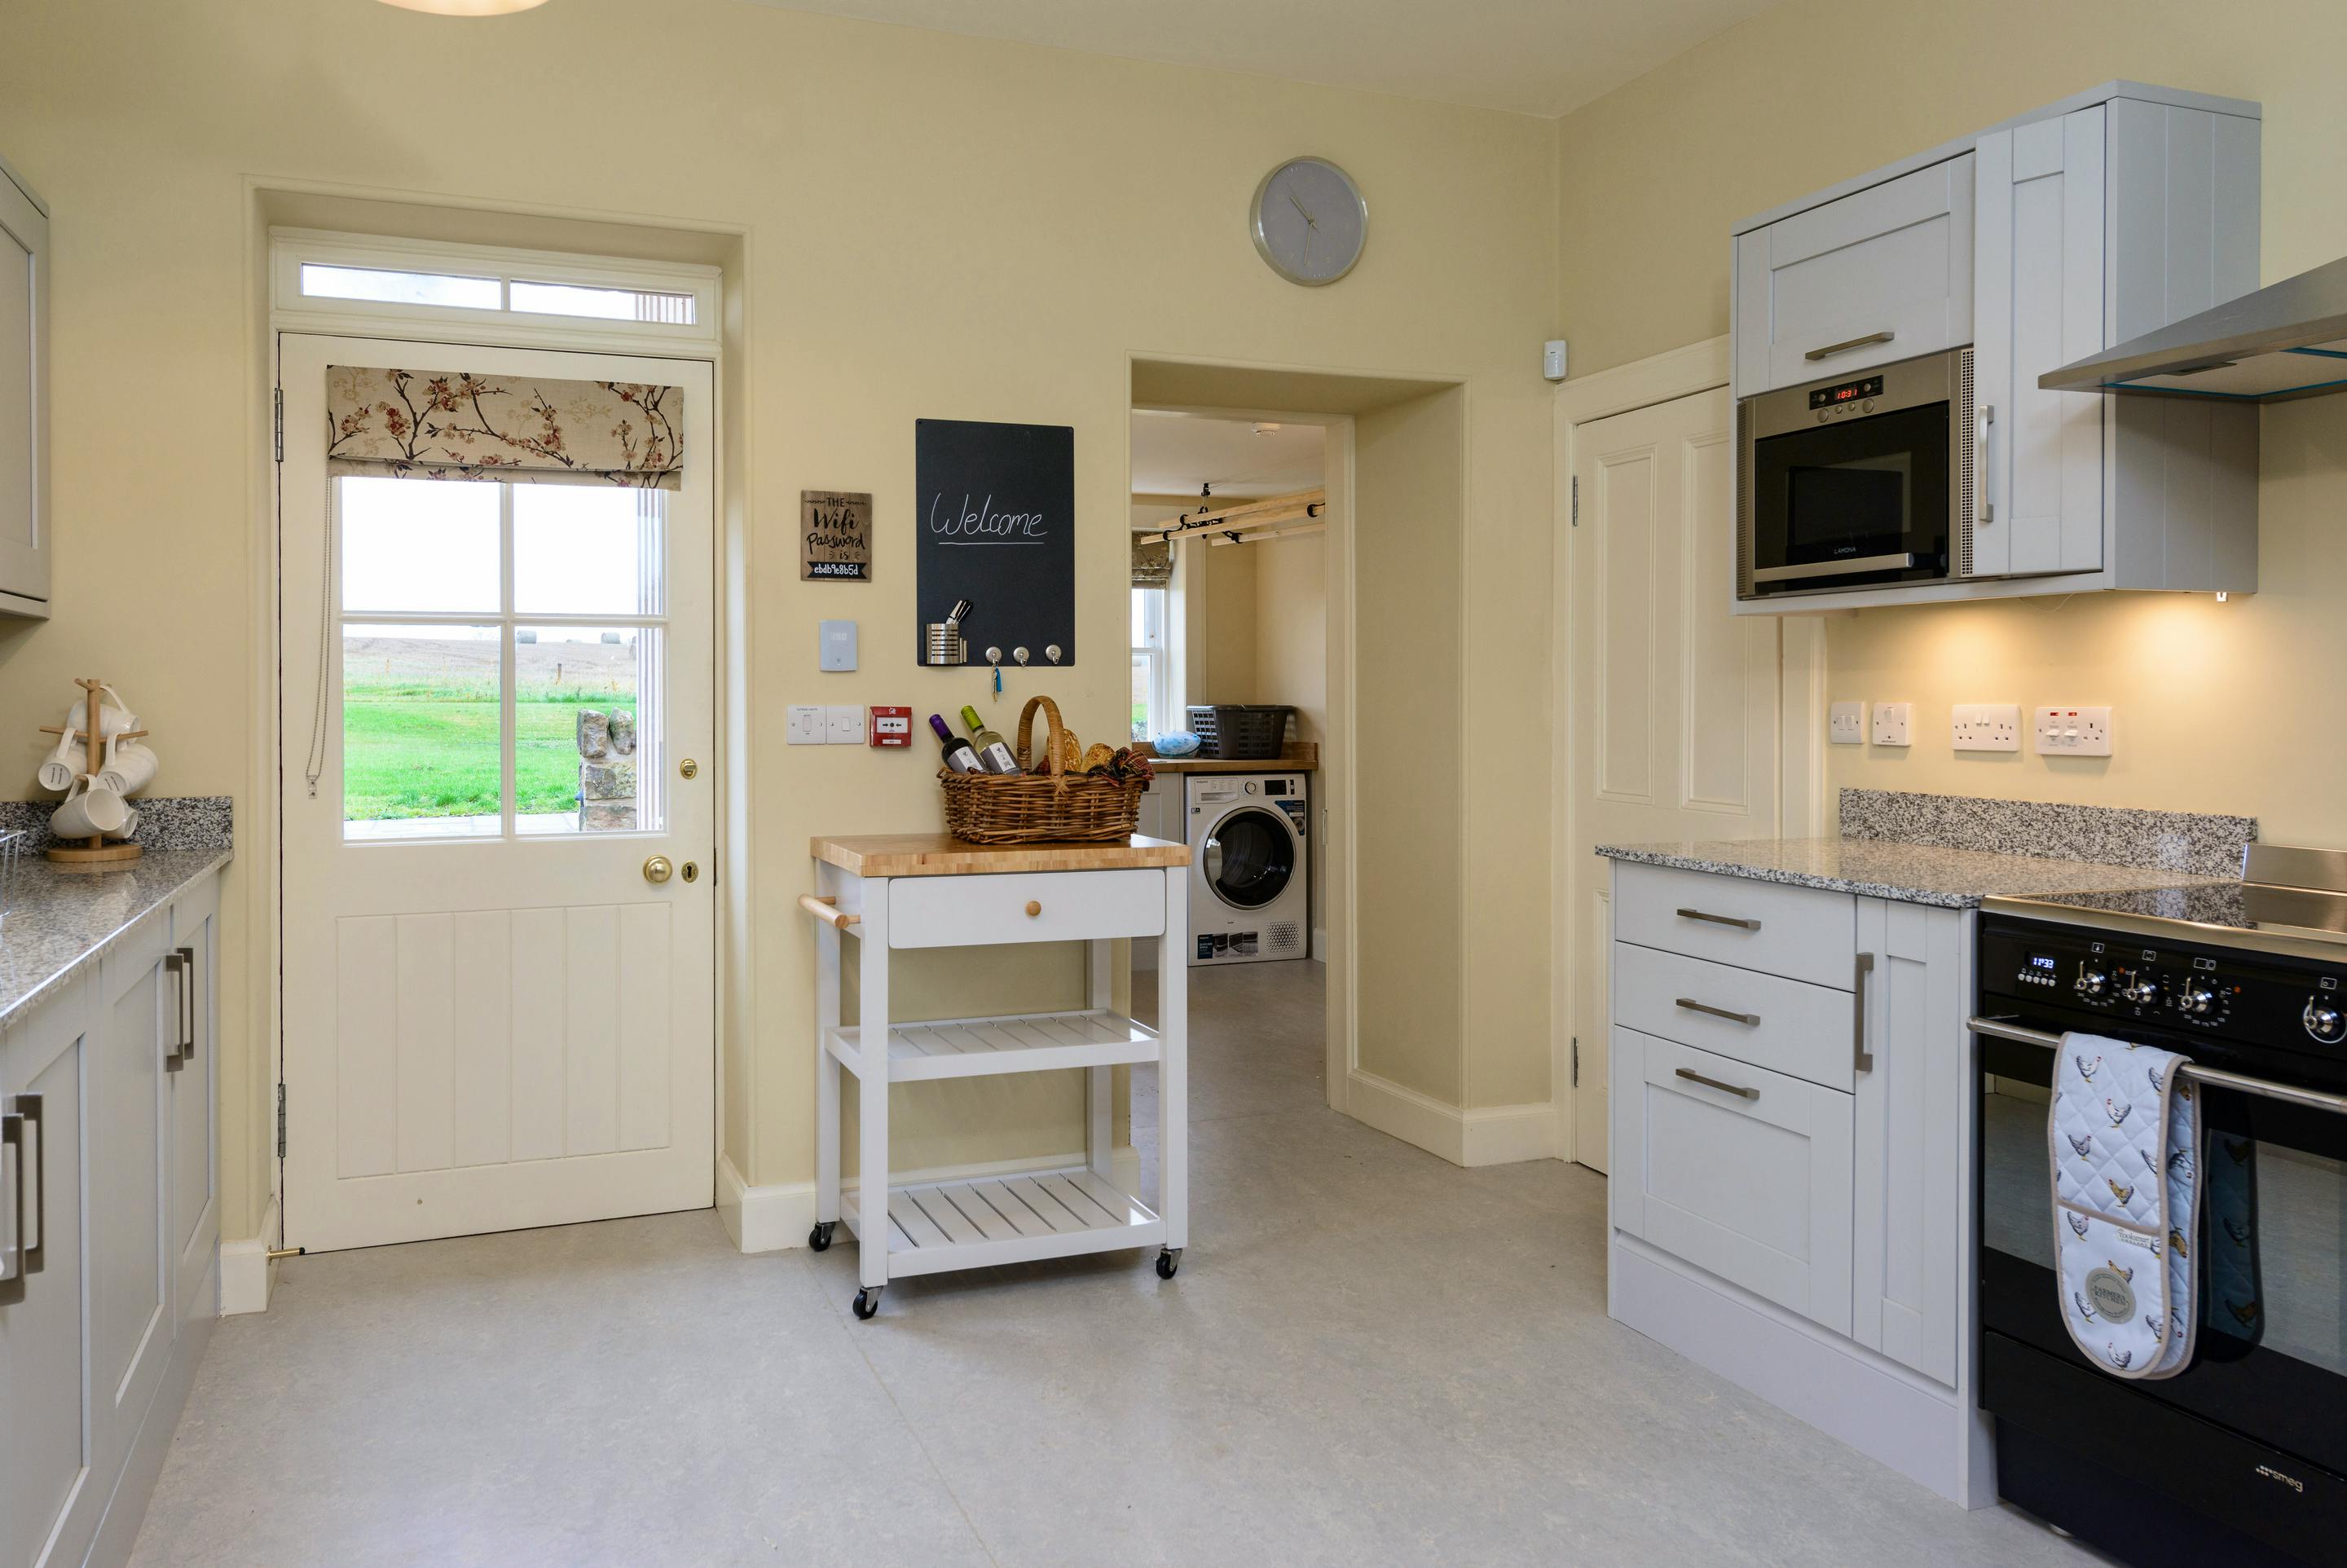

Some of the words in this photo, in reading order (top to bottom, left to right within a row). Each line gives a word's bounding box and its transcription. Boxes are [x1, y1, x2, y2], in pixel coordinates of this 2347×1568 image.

[1837, 389, 1858, 400] 10:31
[826, 497, 845, 508] THE
[813, 508, 860, 535] Wifi
[931, 492, 1048, 537] Welcome
[806, 532, 866, 555] Password
[839, 550, 850, 561] is
[2272, 1471, 2303, 1493] smeg
